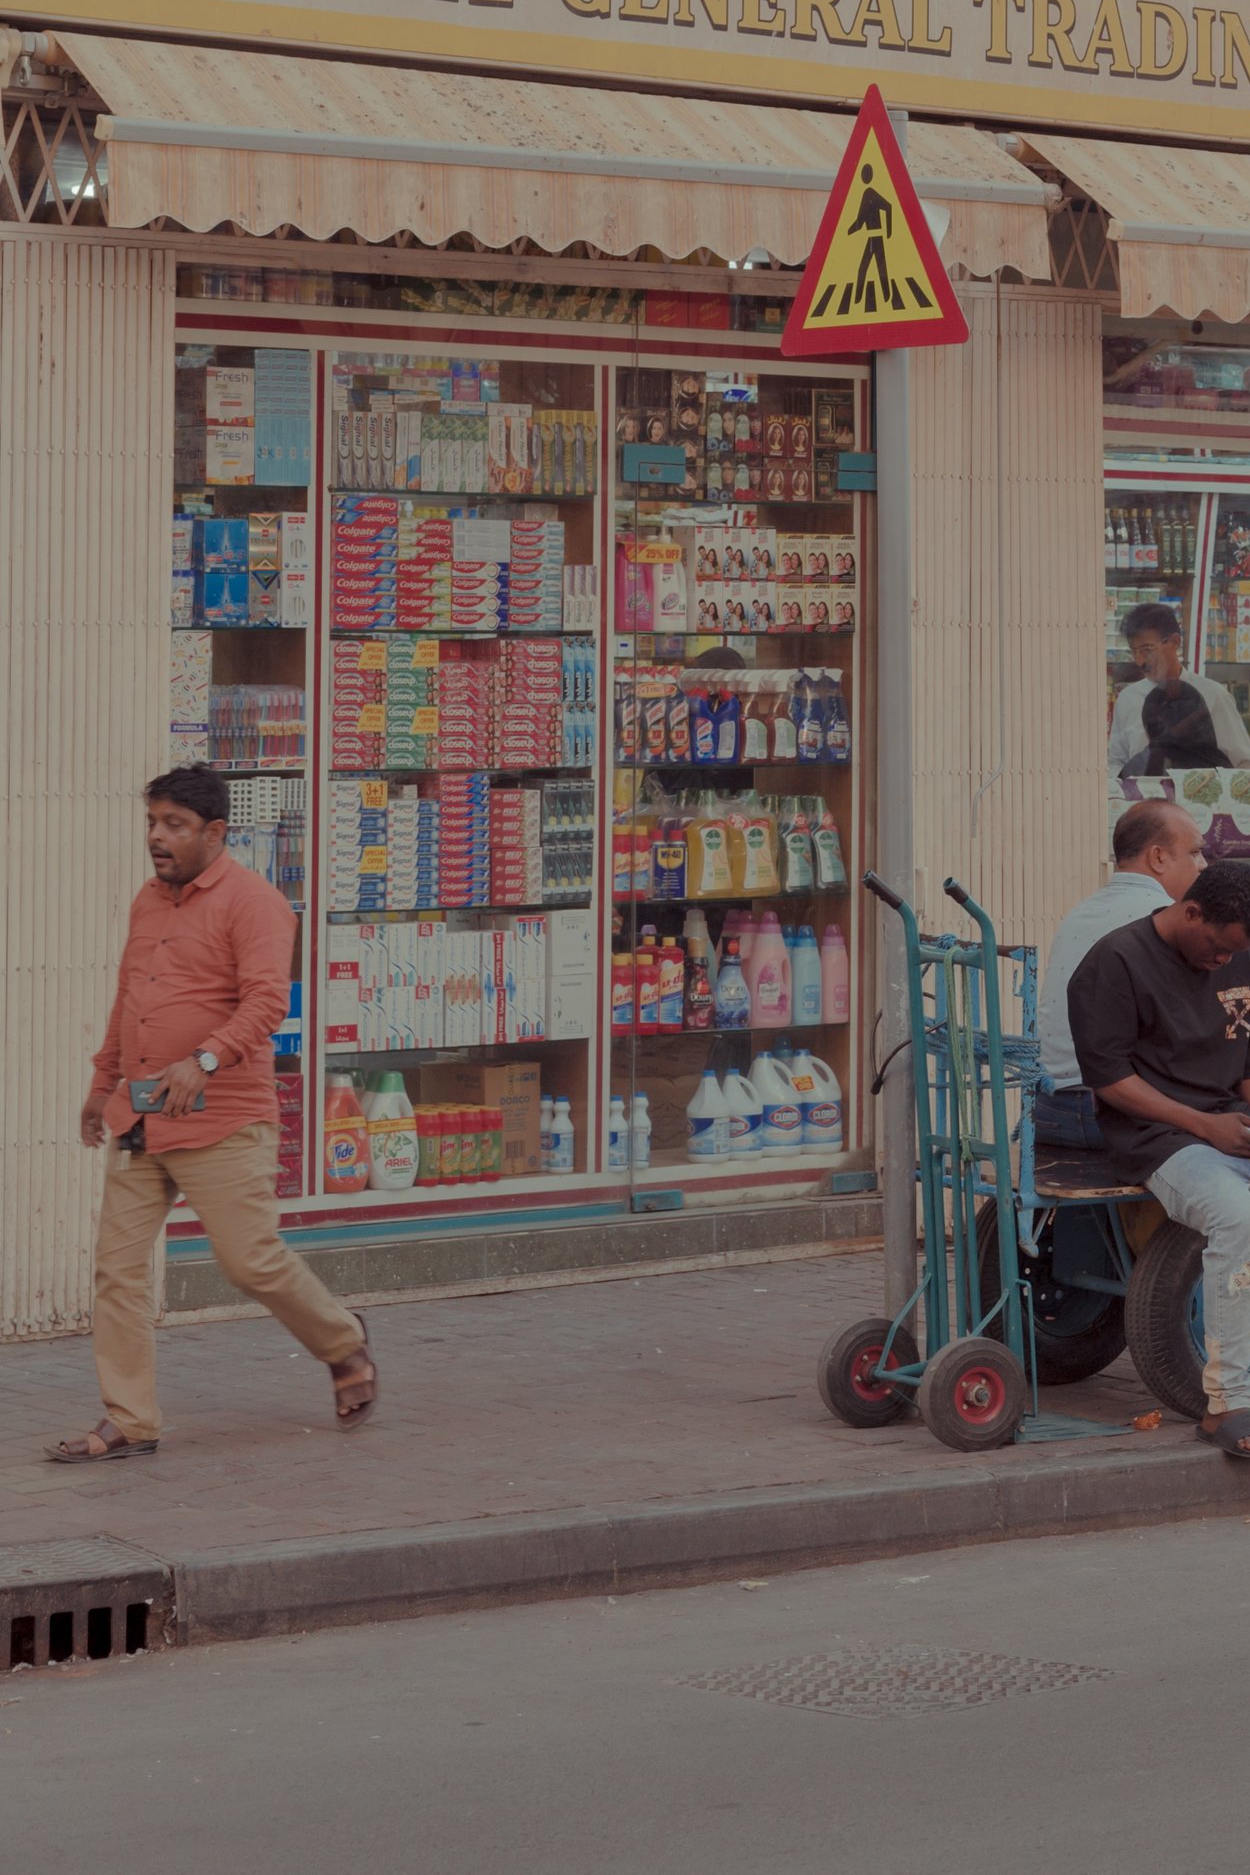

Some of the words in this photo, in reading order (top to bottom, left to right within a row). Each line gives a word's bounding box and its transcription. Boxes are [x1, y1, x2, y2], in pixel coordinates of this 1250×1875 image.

[215, 371, 249, 383] Fresh
[215, 430, 249, 442] Fresh
[363, 501, 396, 509] Colgate
[362, 515, 396, 523] Colgate
[338, 526, 376, 536] Colgate
[421, 524, 451, 532] Colgate
[421, 537, 450, 546] Colgate
[337, 543, 375, 553] Colgate
[421, 552, 450, 560] Colgate
[337, 561, 375, 571] Colgate
[400, 564, 429, 572] Colgate
[337, 579, 375, 588] Colgate
[400, 581, 430, 589] Colgate
[336, 595, 375, 605] Colgate
[400, 598, 429, 606] Colgate
[336, 613, 374, 622] Colgate
[399, 615, 428, 623] Colgate
[366, 783, 384, 796] 3+1
[366, 797, 383, 806] FREE
[330, 1142, 354, 1161] Tide
[385, 1157, 413, 1168] ARIEL
